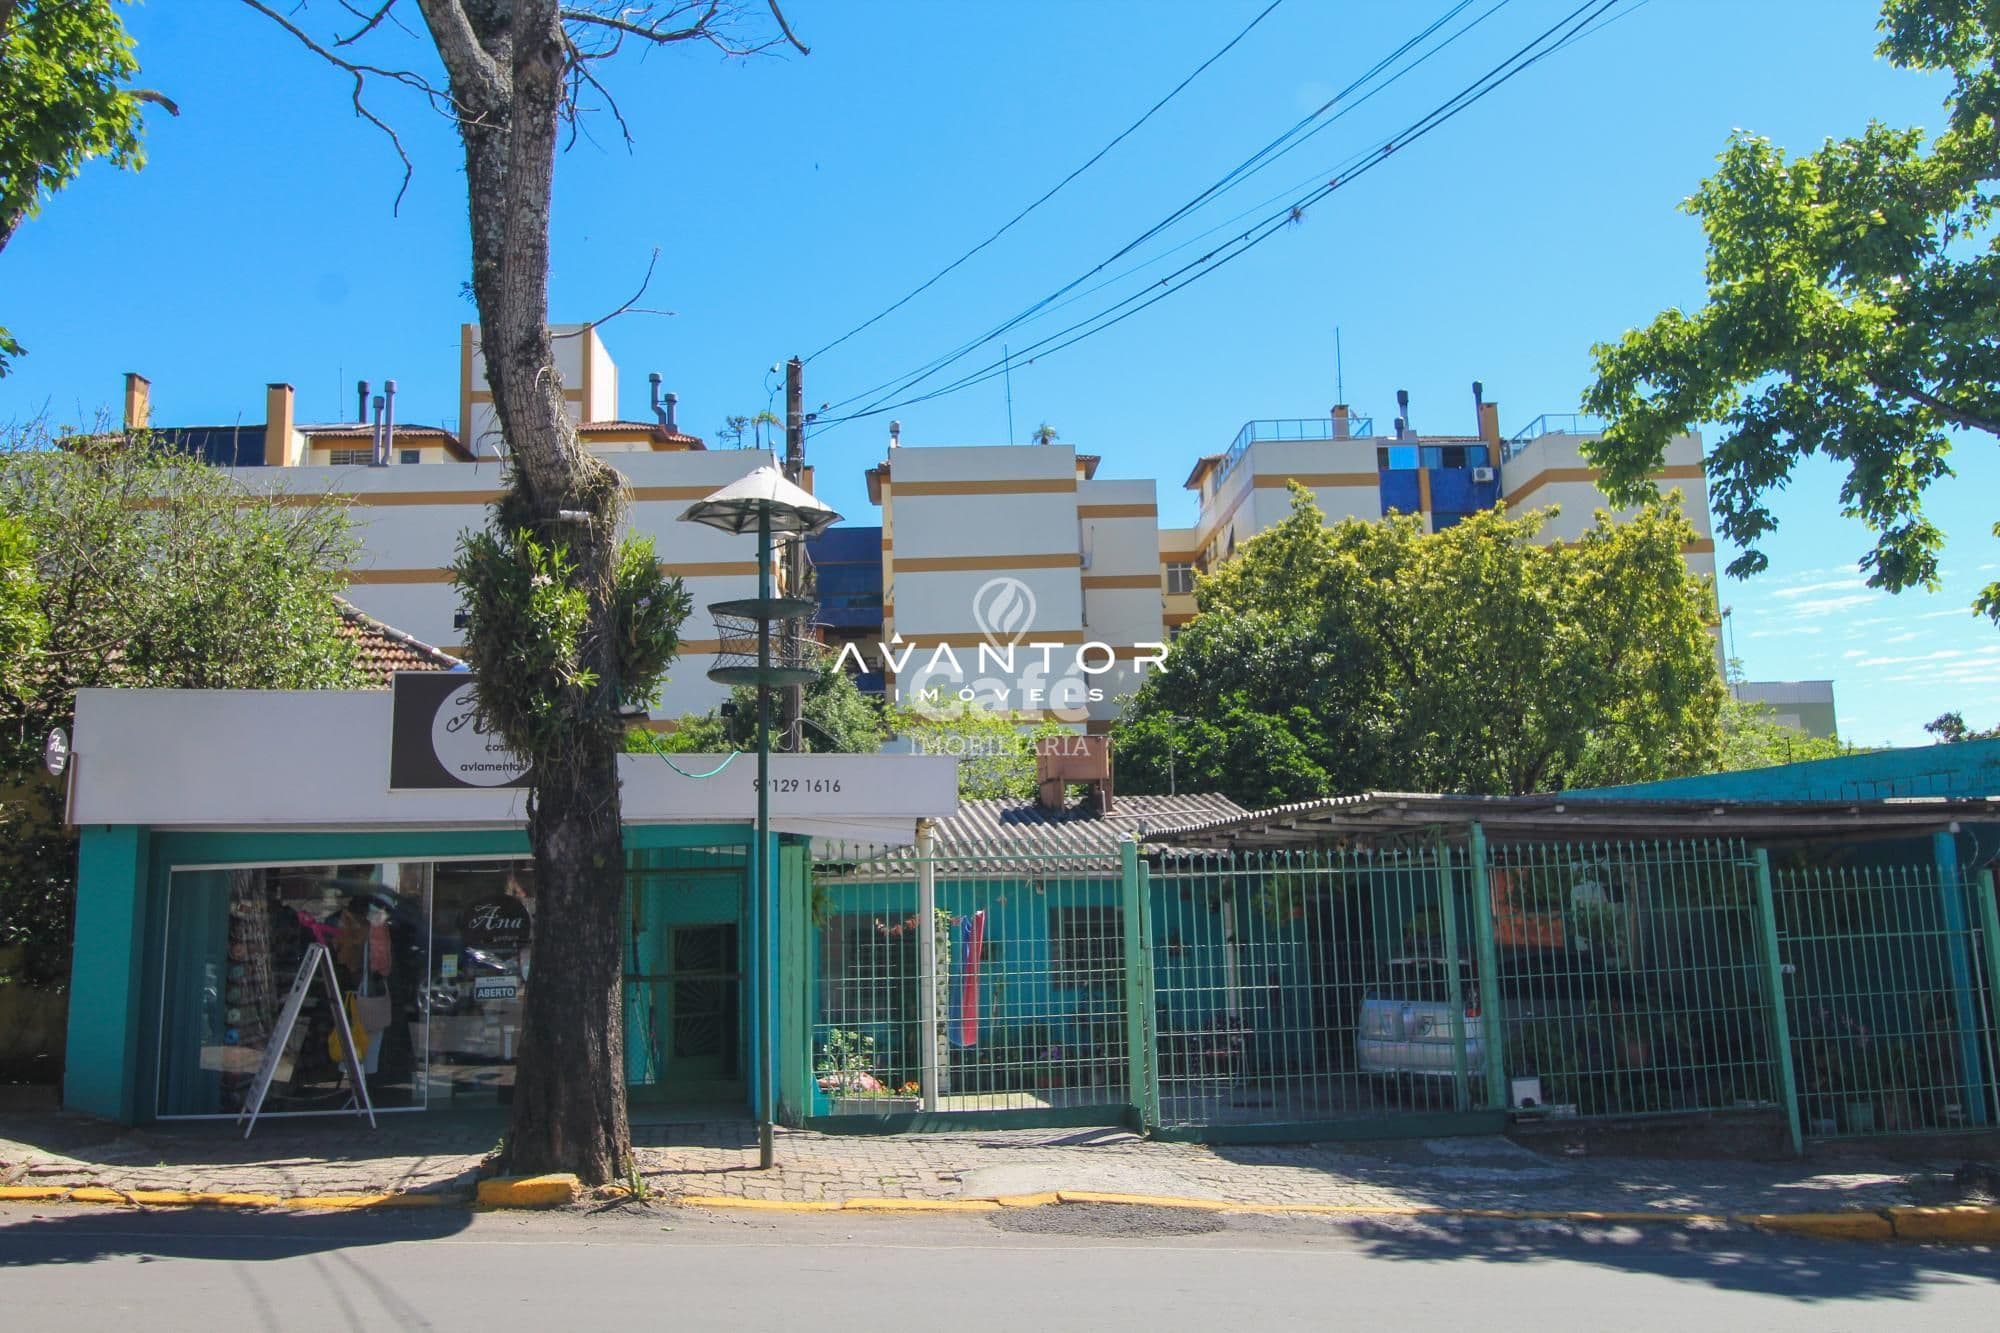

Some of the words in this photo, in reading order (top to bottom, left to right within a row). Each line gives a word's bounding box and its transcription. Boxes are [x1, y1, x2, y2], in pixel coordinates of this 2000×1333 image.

[753, 779, 799, 793] 9129
[805, 779, 841, 793] 1616
[468, 903, 522, 930] Ana
[477, 987, 515, 998] ABERTO
